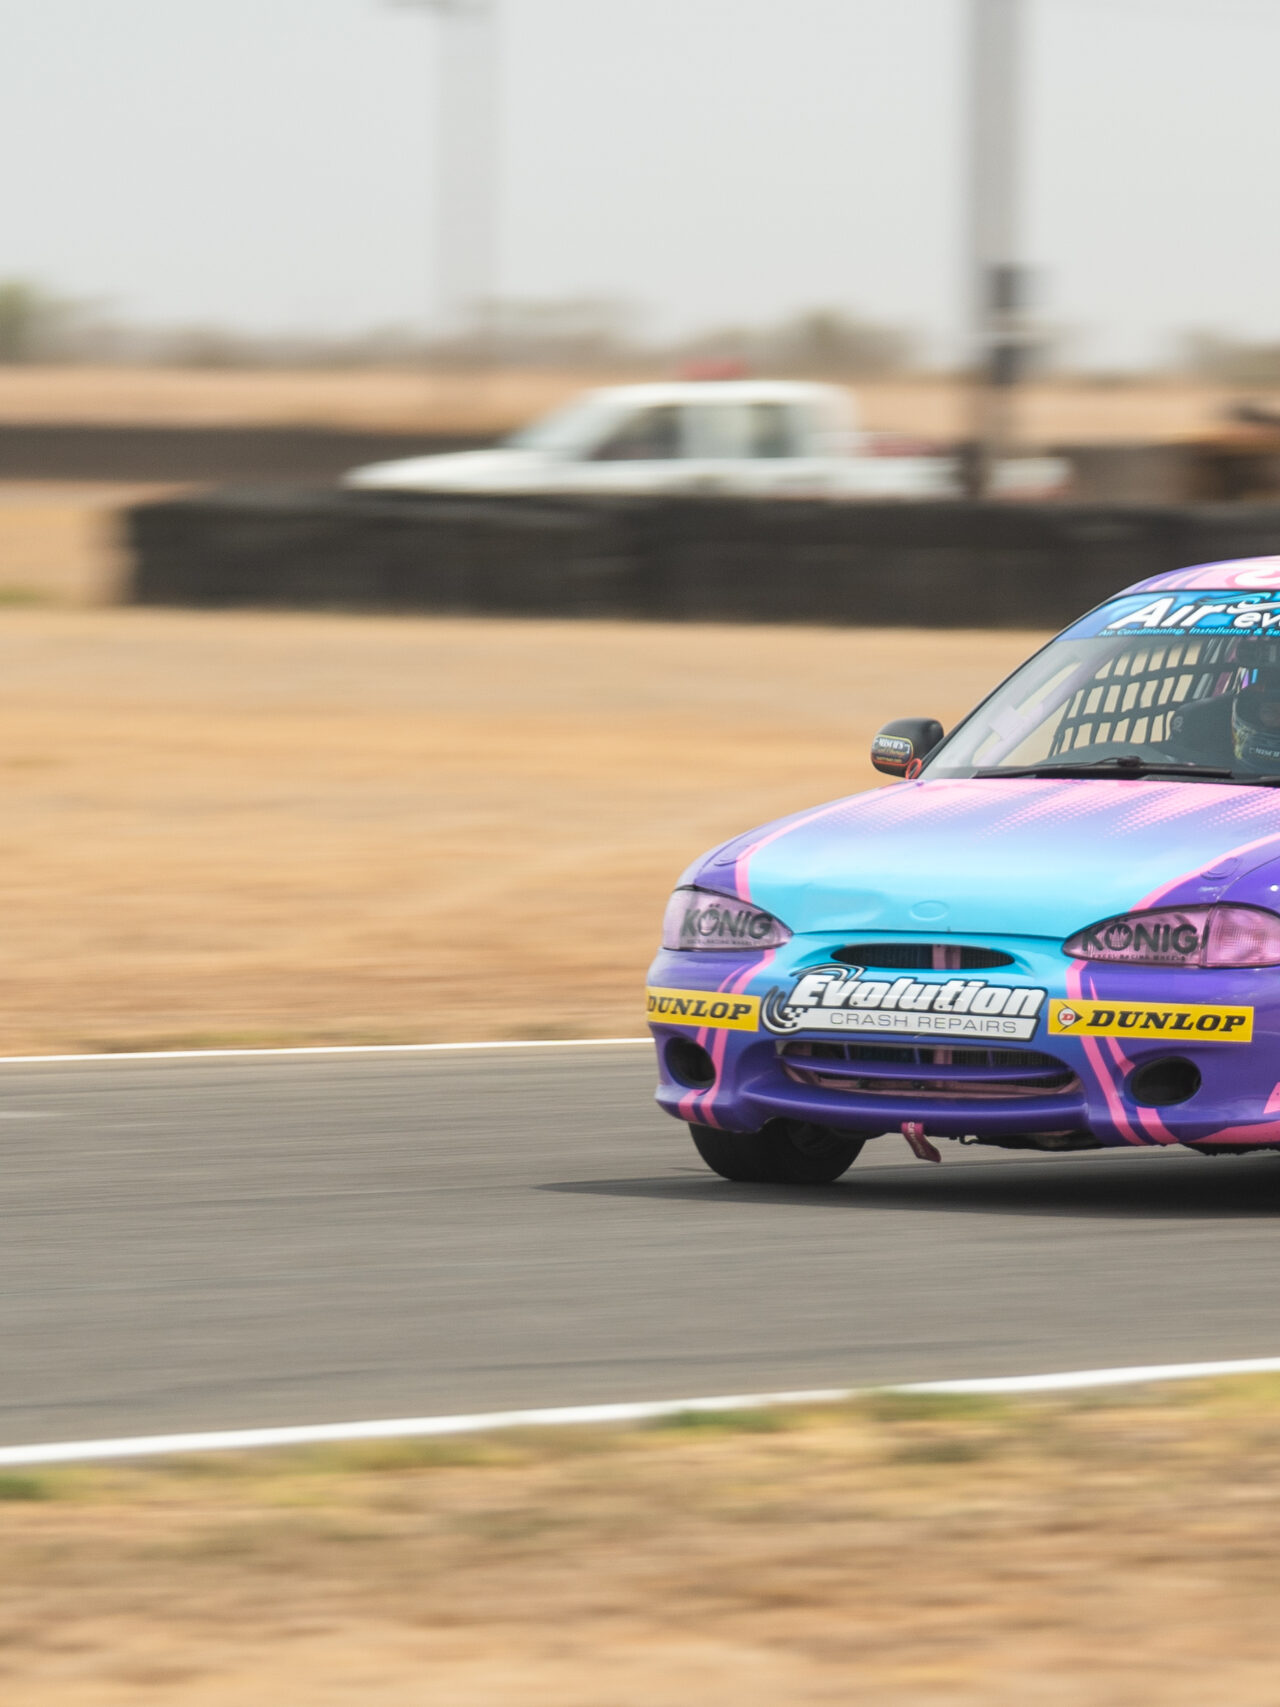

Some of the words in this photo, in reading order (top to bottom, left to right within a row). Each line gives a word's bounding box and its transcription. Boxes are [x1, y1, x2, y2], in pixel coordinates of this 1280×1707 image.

[1107, 597, 1227, 630] Air
[1189, 627, 1250, 636] Installation
[647, 995, 752, 1020] DUNLOP
[787, 974, 1046, 1017] Evolution
[829, 1012, 908, 1028] CRASH
[917, 1015, 1017, 1034] REPAIRS
[1086, 1009, 1246, 1032] DUNLOP
